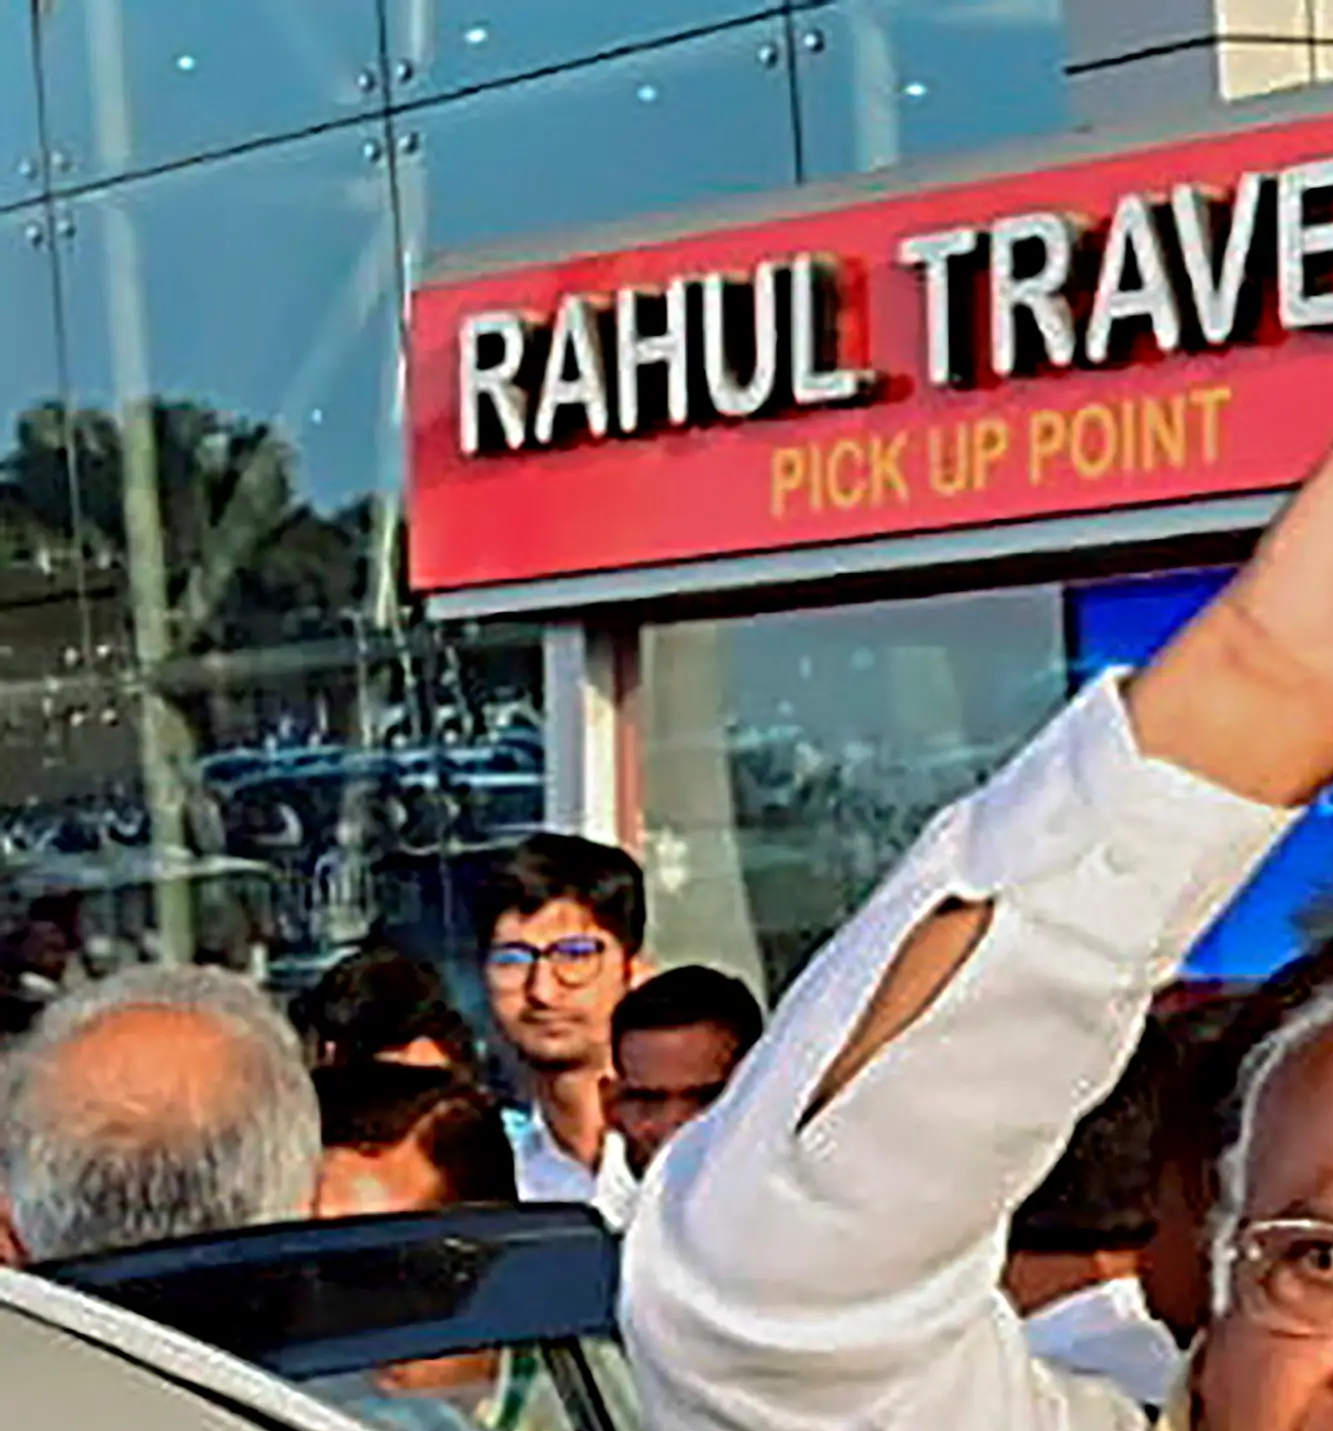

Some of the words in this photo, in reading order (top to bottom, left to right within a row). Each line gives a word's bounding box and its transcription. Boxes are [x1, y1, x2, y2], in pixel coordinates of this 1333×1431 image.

[458, 254, 866, 456] RAHUL
[770, 432, 908, 517] PICK
[927, 412, 1009, 498] UP
[1029, 387, 1232, 485] POINT
